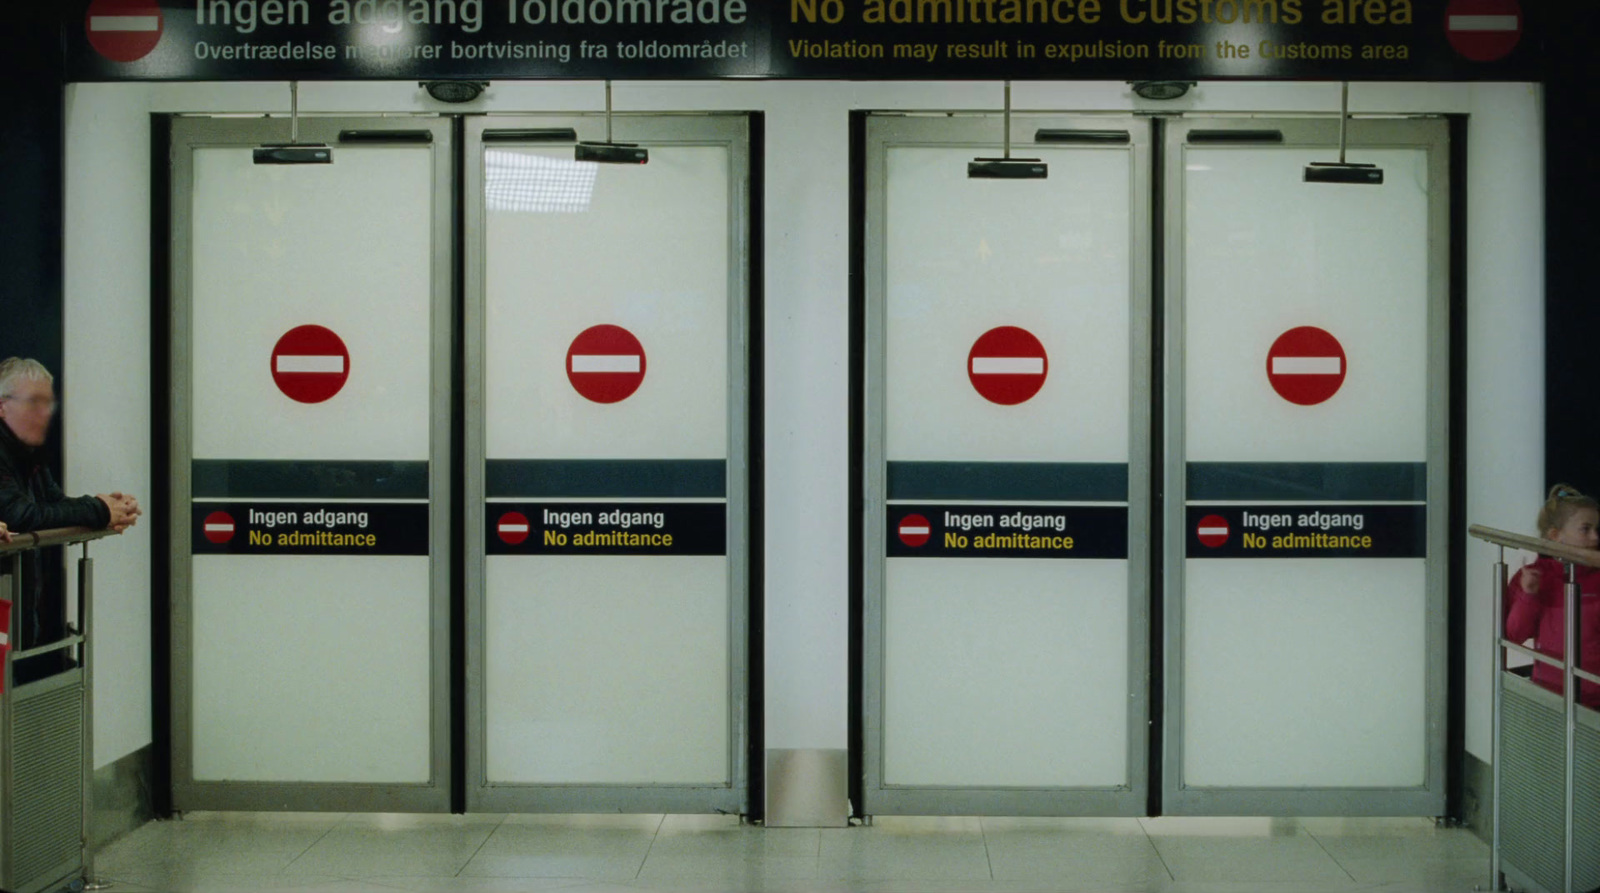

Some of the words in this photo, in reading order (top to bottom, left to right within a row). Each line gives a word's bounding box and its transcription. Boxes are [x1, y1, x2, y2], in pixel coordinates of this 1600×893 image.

[195, 0, 309, 33] Ingen
[327, 0, 483, 33] adgang
[790, 0, 844, 24] No
[862, 0, 1101, 24] admittance
[1119, 0, 1303, 24] Customs
[1321, 0, 1413, 24] area
[194, 40, 337, 60] Overtrædelse
[345, 40, 443, 60] medrer
[451, 40, 571, 63] bortvisning
[579, 40, 608, 59] fra
[616, 39, 748, 59] toldområdet
[788, 39, 884, 58] Violation
[893, 43, 938, 63] may
[947, 39, 1008, 58] result
[1017, 40, 1036, 58] in
[1044, 39, 1149, 63] expulsion
[1158, 40, 1206, 59] from
[1216, 40, 1250, 59] the
[1258, 40, 1353, 59] Customs
[1361, 44, 1409, 59] area
[249, 508, 298, 528] Ingen
[302, 508, 369, 528] adgang
[543, 508, 593, 528] Ingen
[597, 508, 665, 528] adgang
[944, 510, 994, 530] Ingen
[999, 510, 1066, 531] adgang
[1242, 510, 1293, 530] Ingen
[1297, 510, 1364, 531] adgang
[249, 530, 273, 546] No
[277, 530, 376, 547] admittance
[543, 530, 568, 546] No
[572, 530, 673, 547] admittance
[944, 532, 969, 549] No
[973, 532, 1074, 550] admittance
[1243, 532, 1267, 549] No
[1272, 532, 1372, 549] admittance
